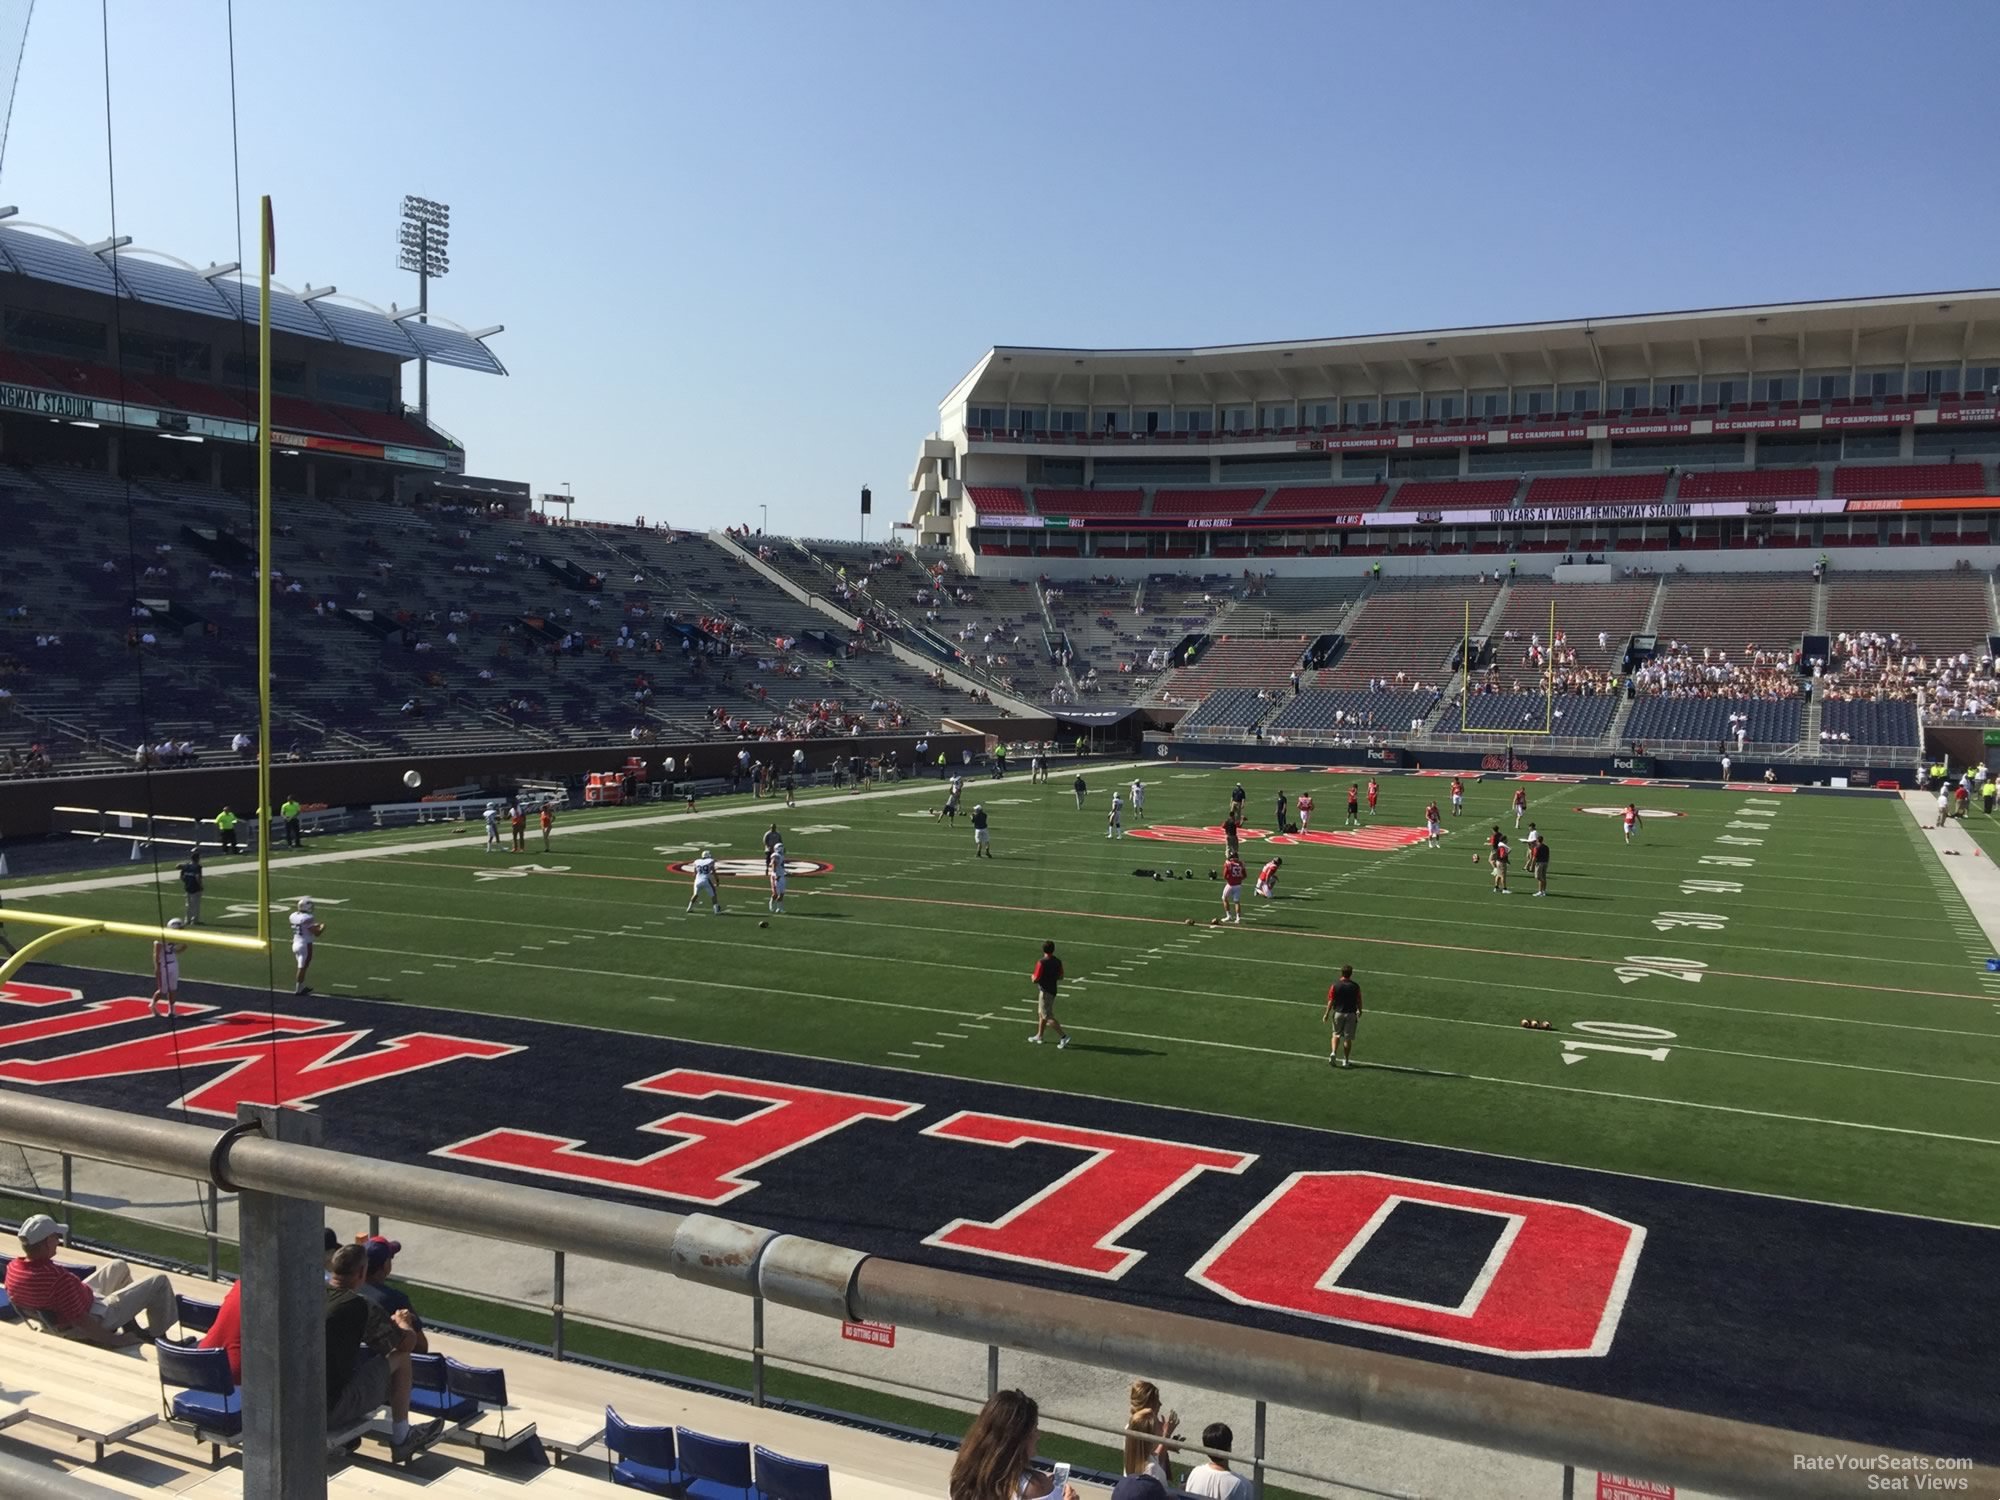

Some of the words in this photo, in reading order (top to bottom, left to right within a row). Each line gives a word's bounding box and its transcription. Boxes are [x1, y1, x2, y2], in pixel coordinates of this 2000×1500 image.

[44, 393, 93, 418] STADIUM
[1715, 422, 1730, 430] SEC
[1731, 420, 1775, 429] CHAMPIONS
[1825, 416, 1841, 425] SEC
[1842, 414, 1889, 424] CHAMPIONS
[1510, 432, 1523, 440] SEC
[1525, 430, 1565, 439] CHAMPIONS
[1610, 427, 1622, 435] SEC
[1623, 426, 1668, 434] CHAMPIONS
[1430, 435, 1467, 443] CHAMPIONS
[1863, 499, 1903, 511] SKYHAWKS
[1490, 509, 1504, 522] 100
[1507, 508, 1535, 521] YEARS
[1537, 507, 1550, 521] AT
[1649, 503, 1691, 518] STADIUM
[1187, 519, 1198, 527] OLE
[1199, 518, 1213, 527] MISS
[1213, 518, 1233, 527] REBELS
[1335, 515, 1347, 524] OLE
[1367, 749, 1396, 759] FedEx
[1613, 758, 1645, 769] FedEx
[1231, 866, 1243, 877] 53
[1650, 911, 1730, 930] 30
[1613, 955, 1709, 983] 20
[1559, 1021, 1678, 1062] 10
[845, 1326, 852, 1336] NO
[853, 1327, 872, 1340] SITTING
[871, 1330, 879, 1341] ON
[879, 1332, 890, 1344] RAIL
